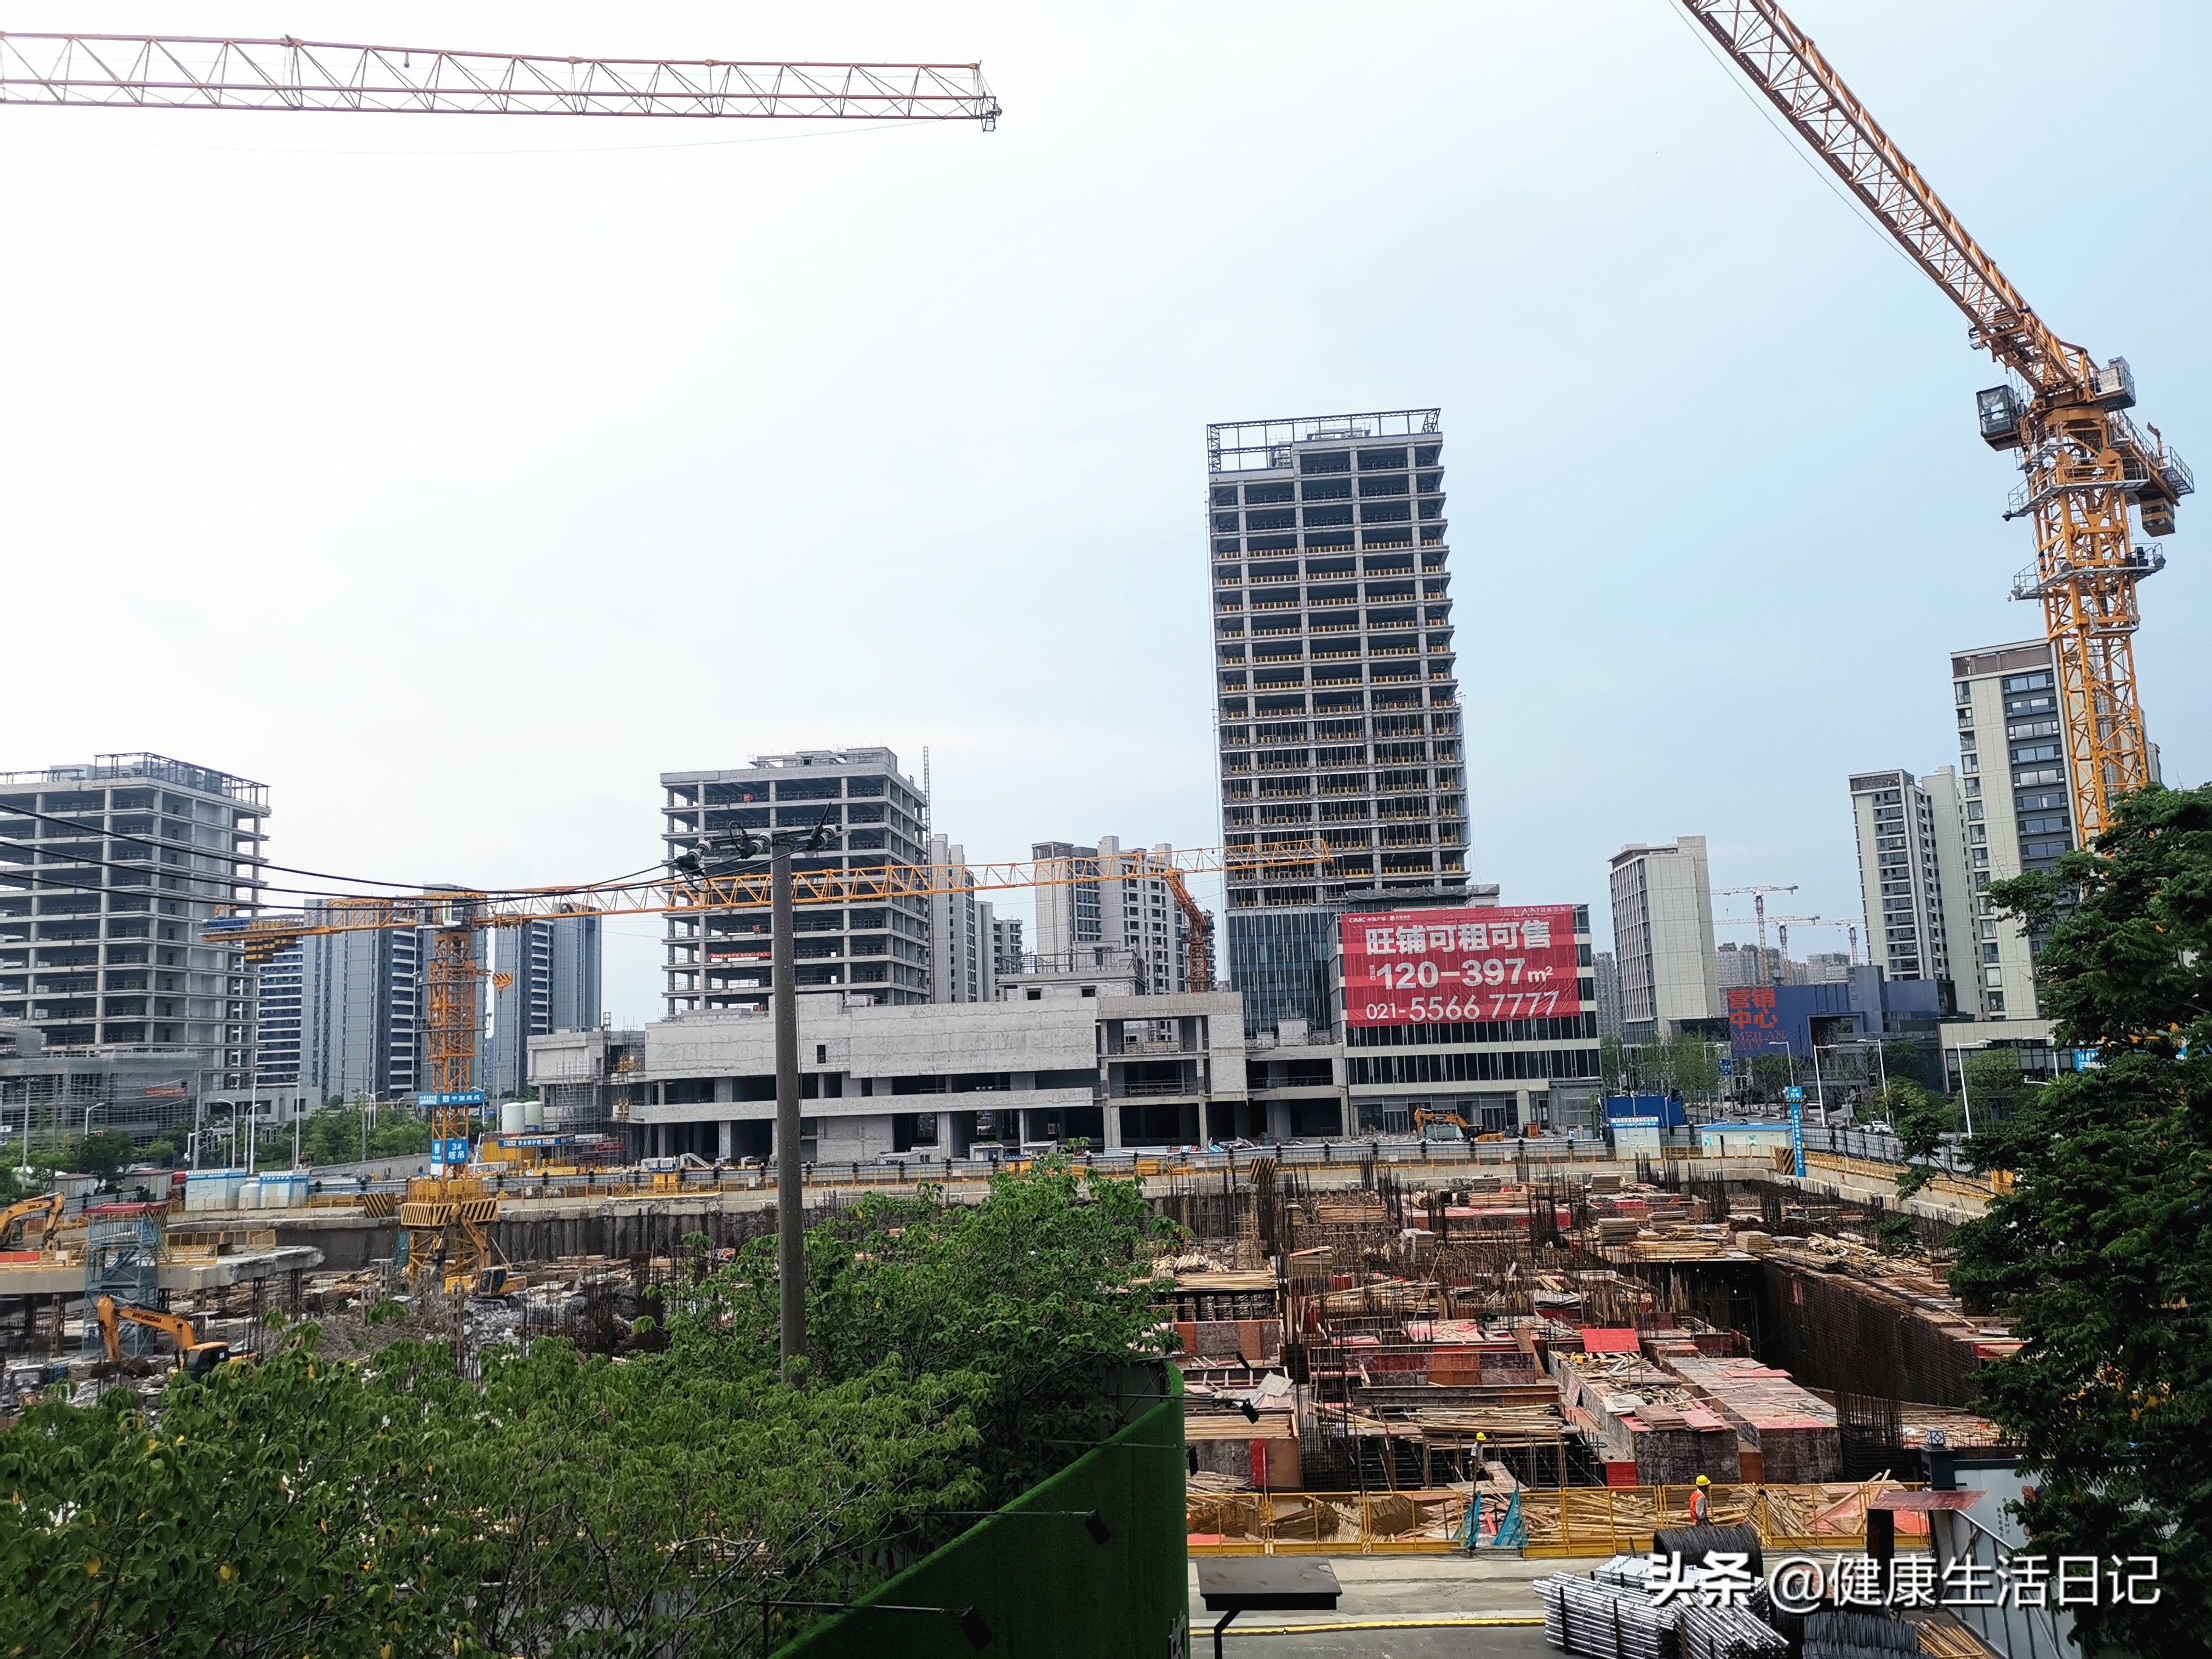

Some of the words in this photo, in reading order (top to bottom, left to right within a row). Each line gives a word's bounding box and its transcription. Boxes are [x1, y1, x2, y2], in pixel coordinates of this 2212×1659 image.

[1366, 919, 1551, 956] 旺铺可租可售
[1489, 990, 1560, 1019] 7777
[1726, 987, 1776, 1010] 营销
[1729, 1008, 1779, 1030] 中心
[448, 1150, 465, 1160] 塔吊
[451, 1142, 462, 1151] 3#
[132, 1312, 163, 1324] HYUNDAI
